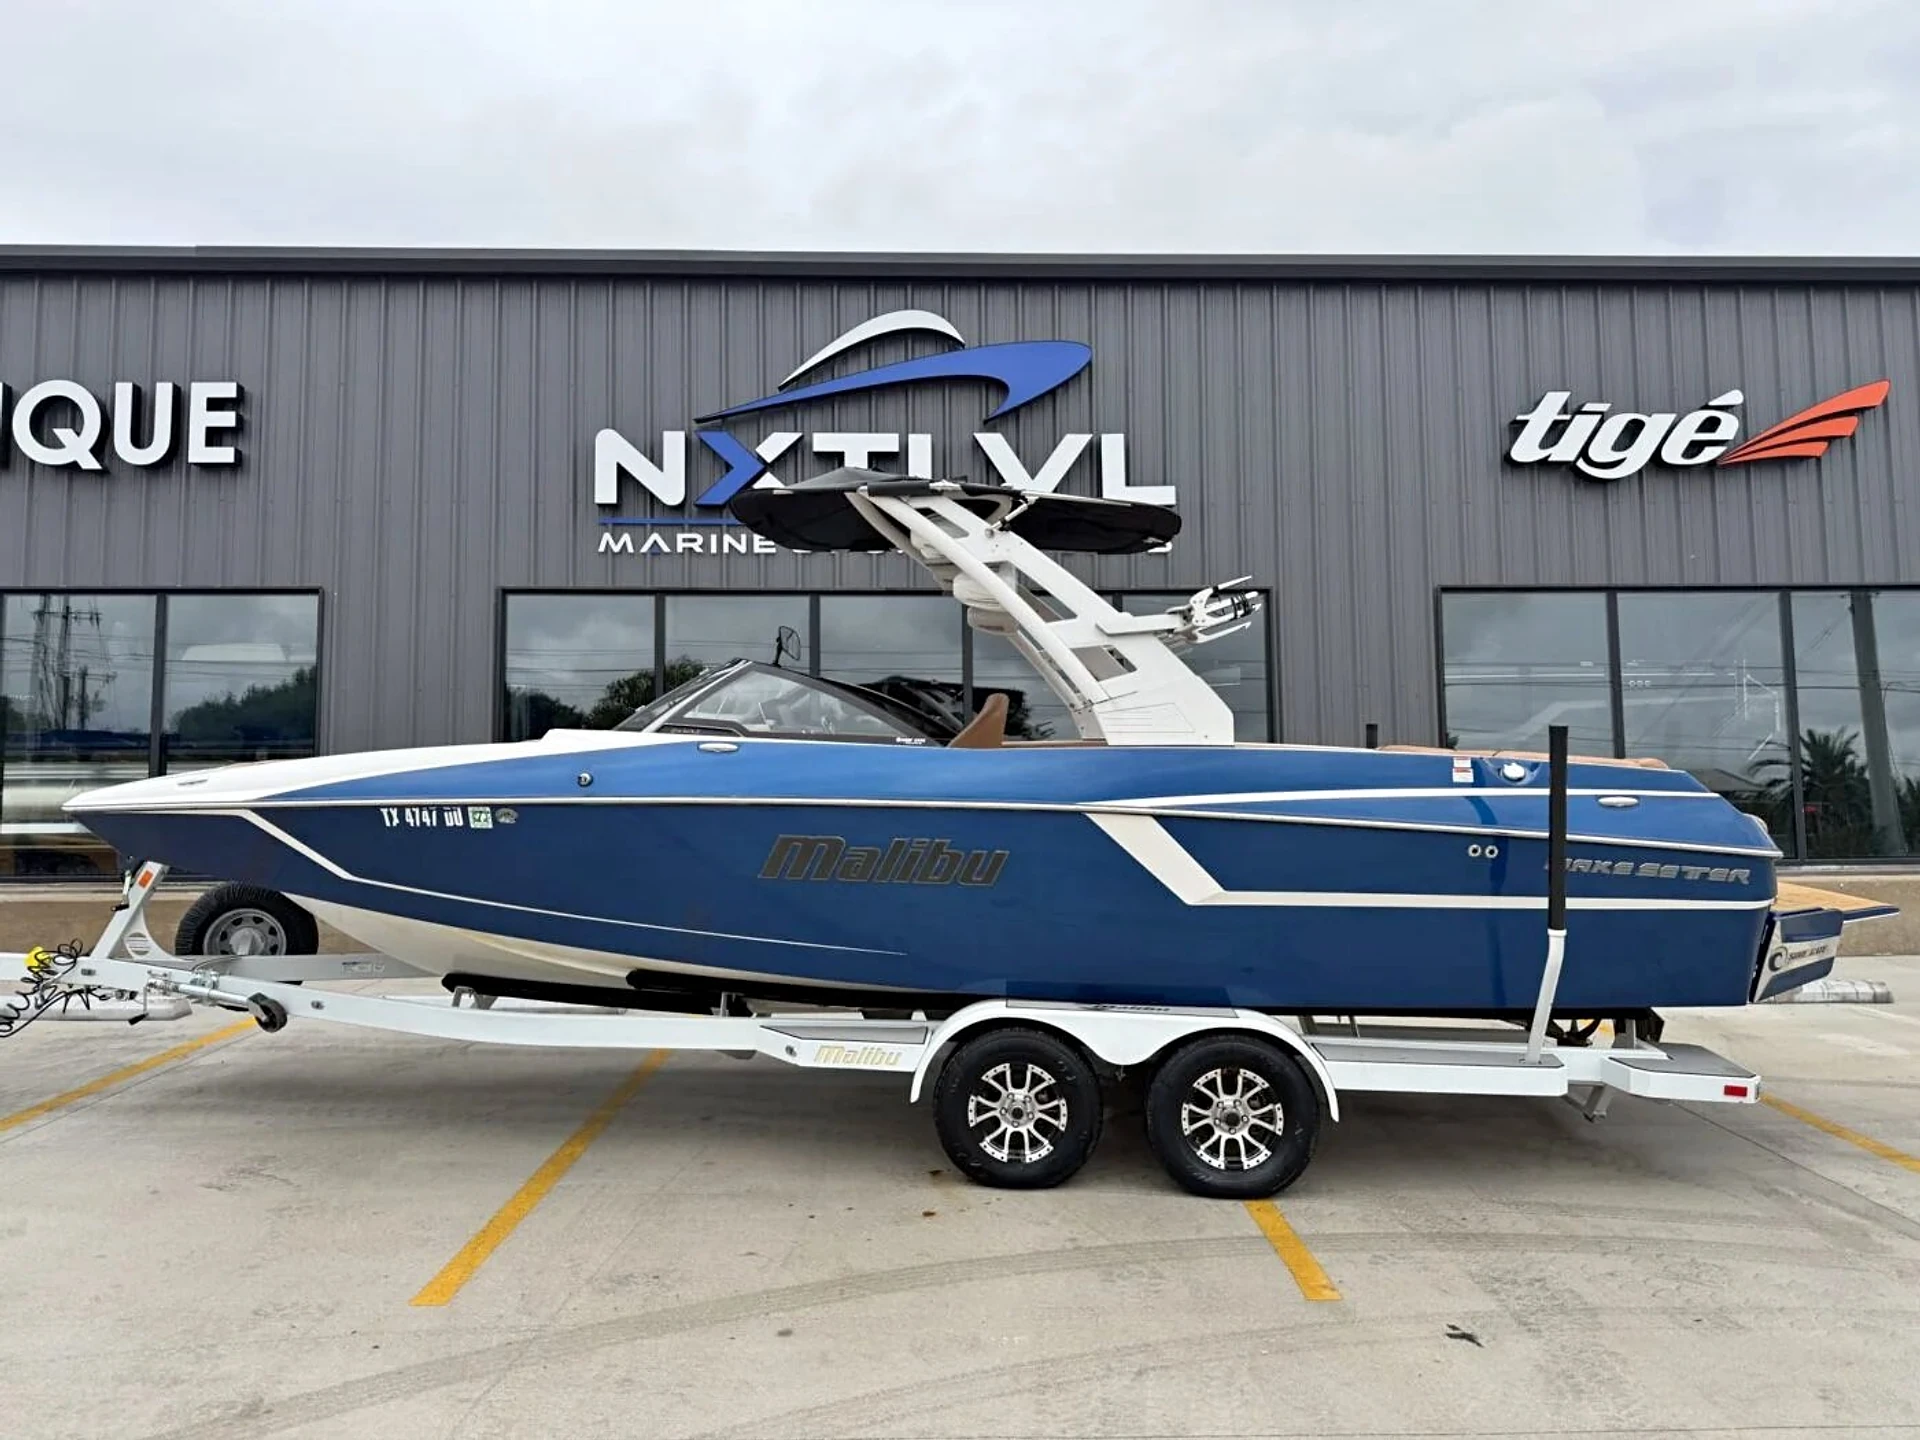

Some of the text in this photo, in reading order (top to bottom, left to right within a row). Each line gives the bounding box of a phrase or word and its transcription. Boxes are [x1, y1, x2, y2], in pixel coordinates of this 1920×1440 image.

[0, 379, 238, 470] QUE
[1509, 389, 1744, 480] tigé
[598, 532, 777, 554] MARINE
[380, 807, 400, 827] TX
[405, 807, 437, 827] 4747
[757, 834, 1010, 886] Malibu
[813, 1044, 903, 1066] Malibu
